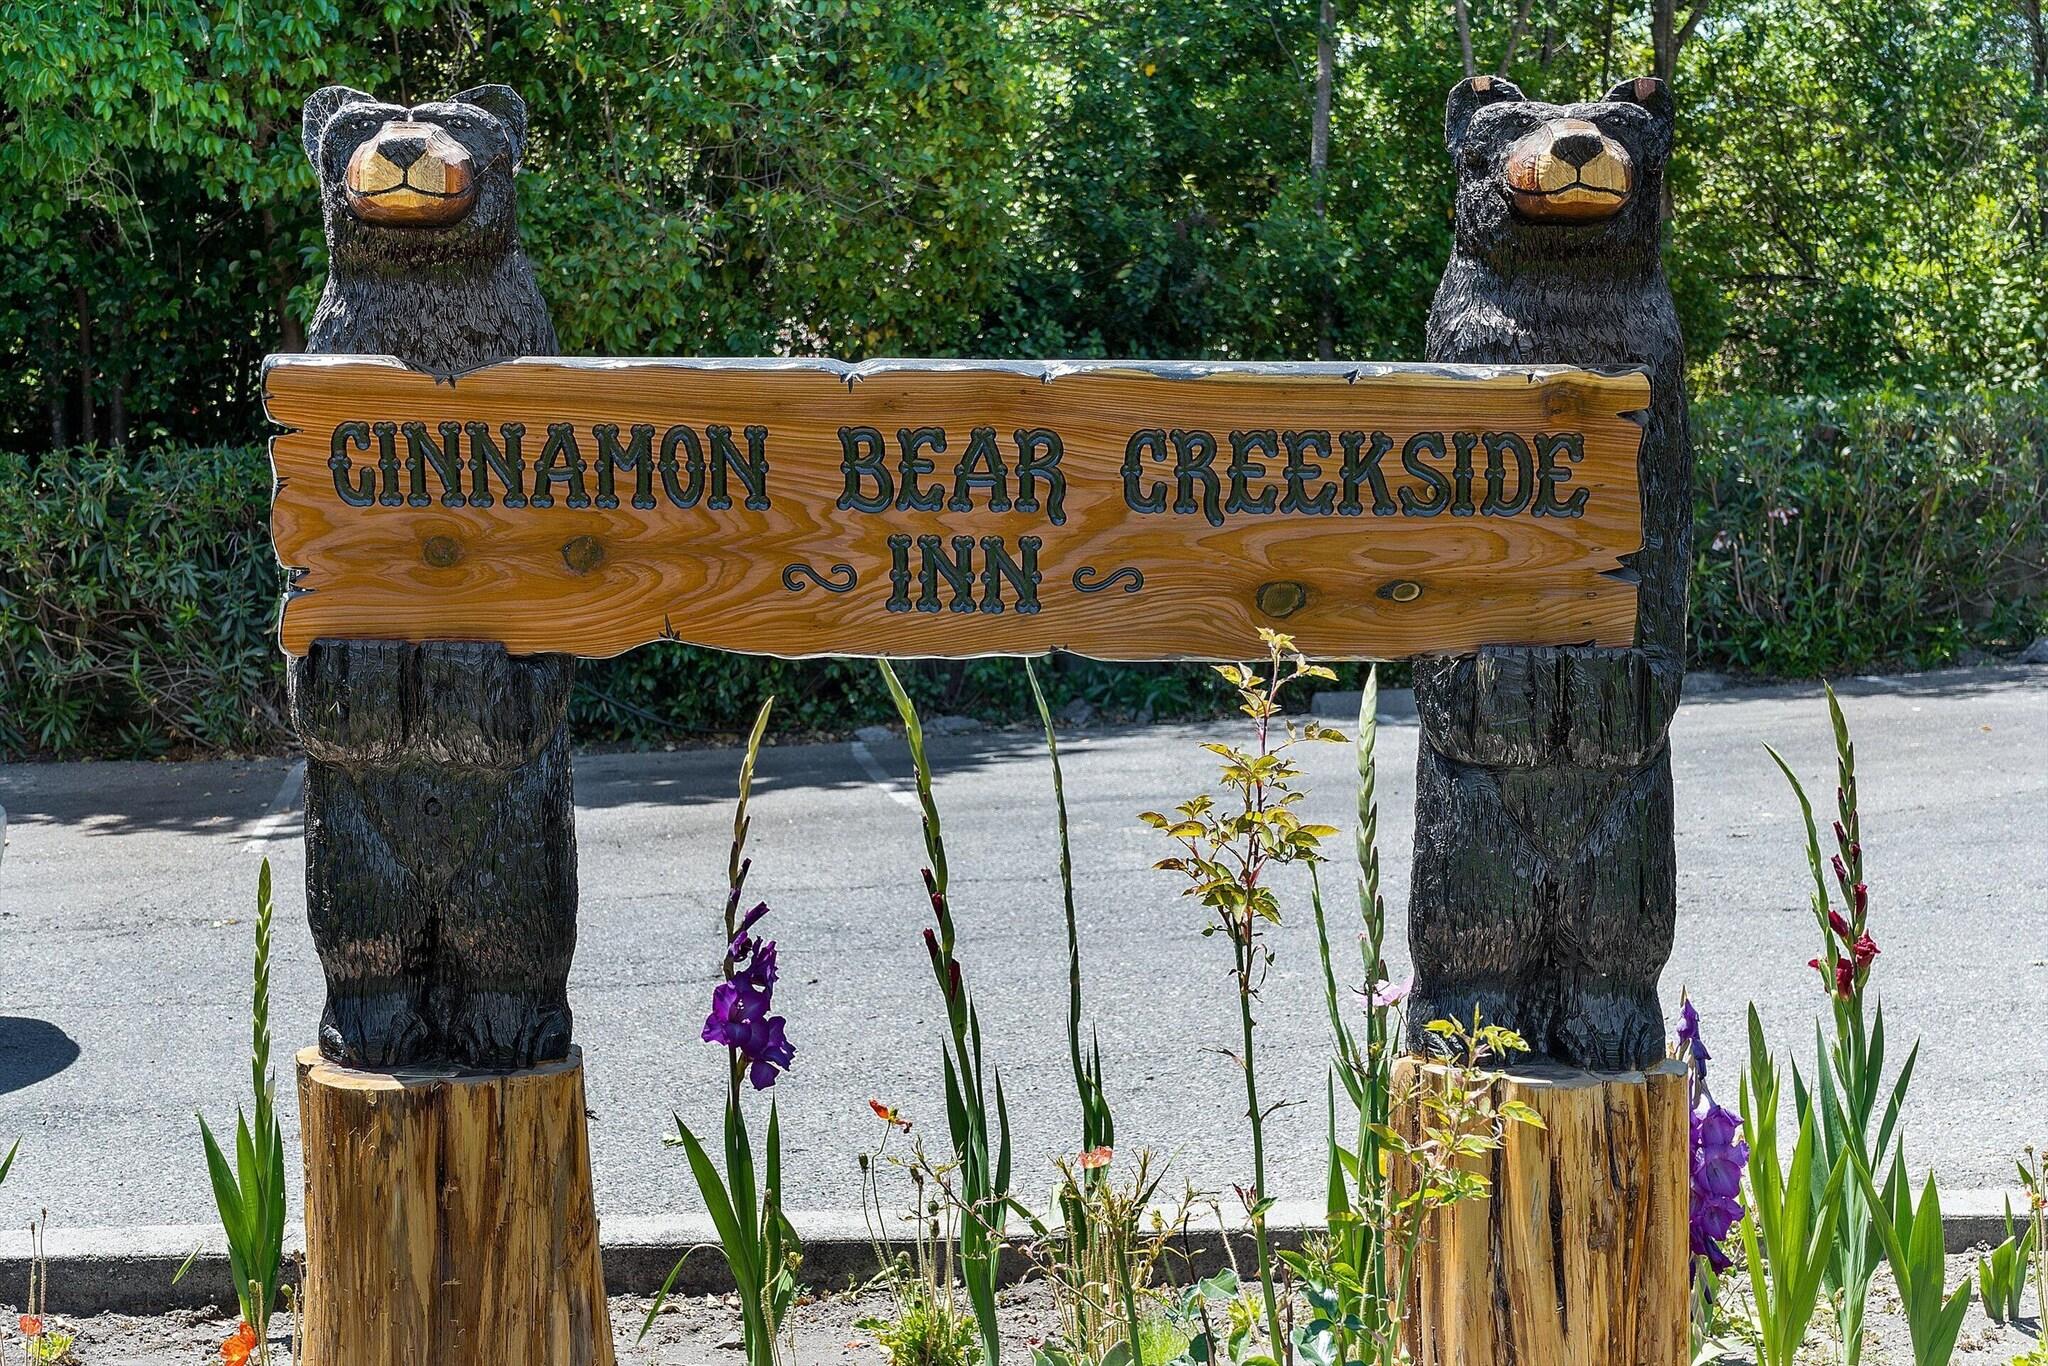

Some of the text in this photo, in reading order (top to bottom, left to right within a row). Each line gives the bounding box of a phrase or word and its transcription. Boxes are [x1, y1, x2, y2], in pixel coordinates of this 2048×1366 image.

[328, 420, 1590, 527] CINNAMON BEAR CREEKSIDE
[885, 533, 1042, 614] INN
